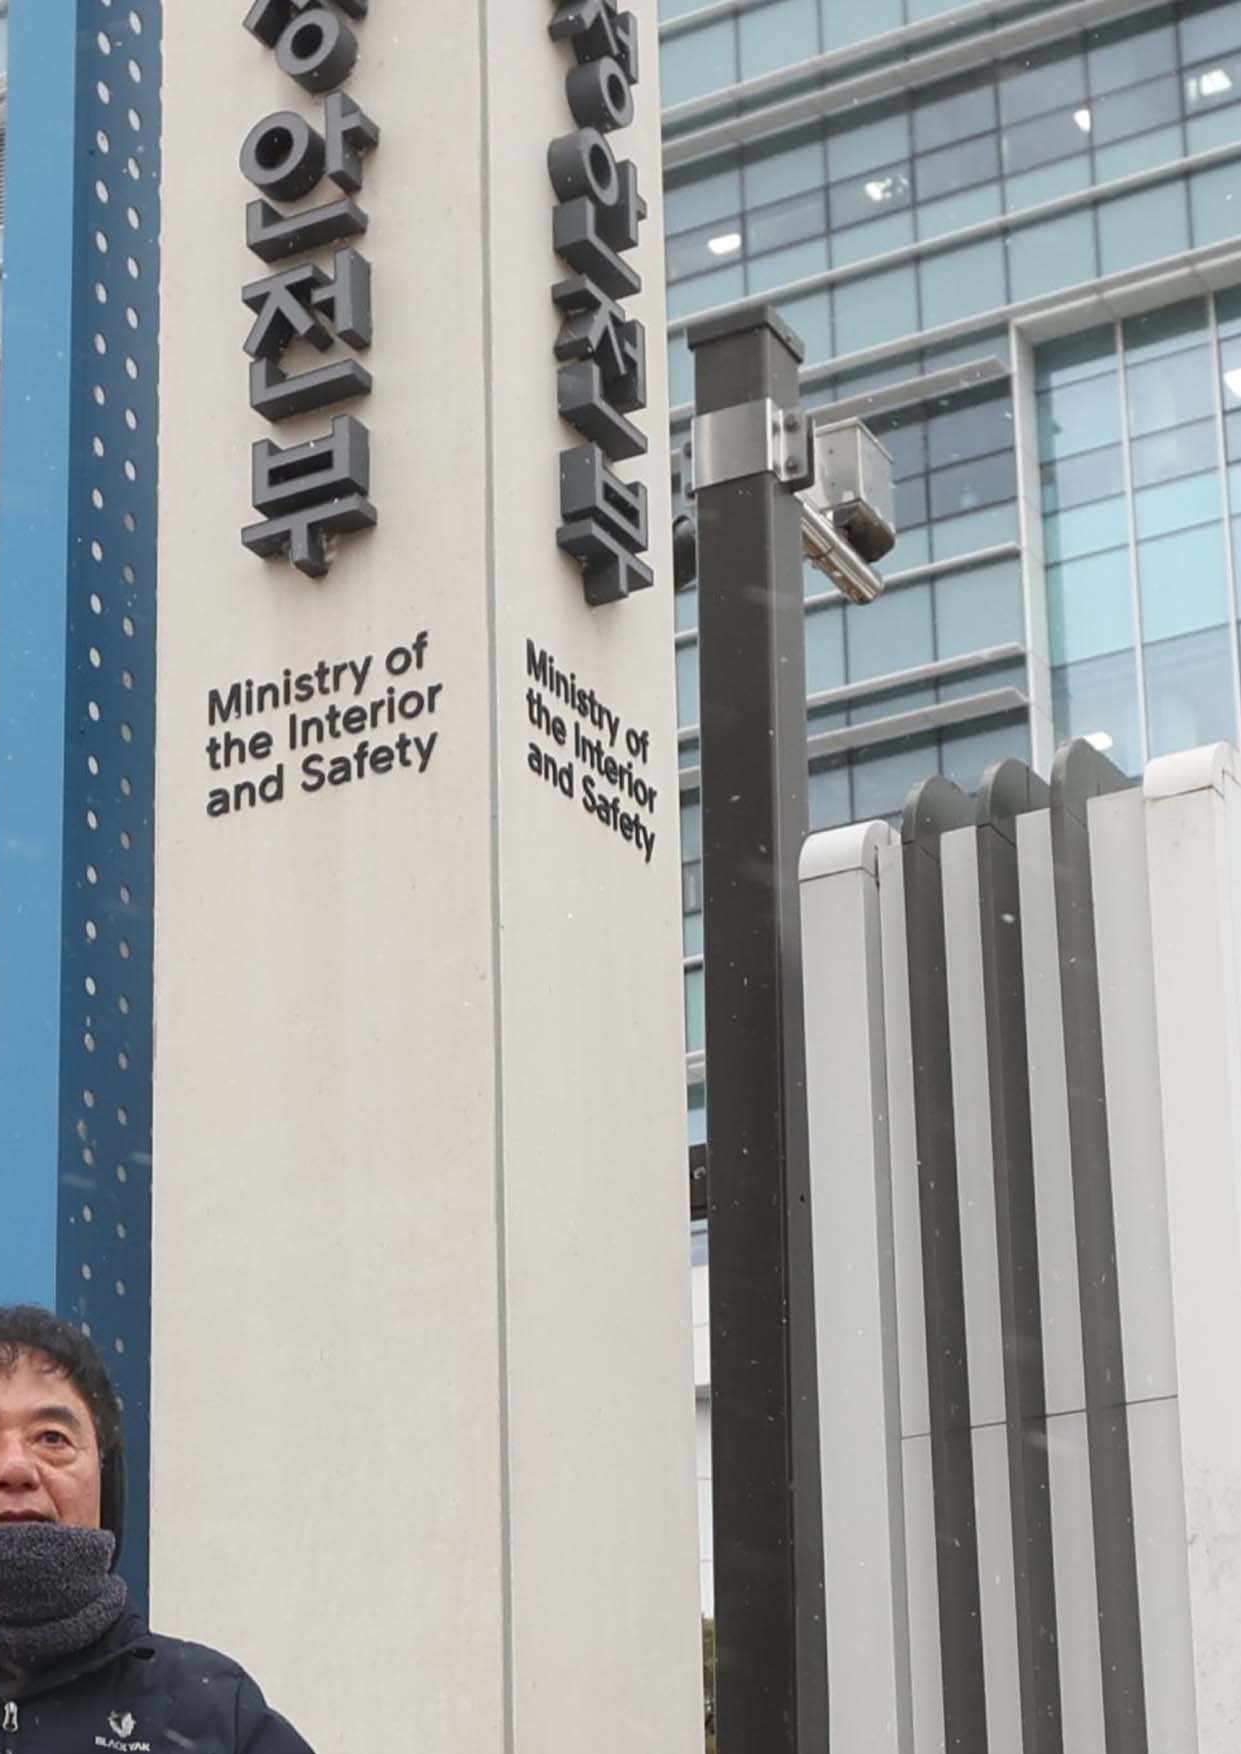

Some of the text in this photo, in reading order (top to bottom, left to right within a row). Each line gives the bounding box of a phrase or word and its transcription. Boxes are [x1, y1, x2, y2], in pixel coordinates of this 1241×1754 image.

[206, 683, 443, 771] the Interior
[207, 631, 429, 727] Ministry of
[526, 637, 649, 763] Ministry of
[206, 731, 438, 818] and Safety
[526, 688, 657, 814] the Interior
[527, 740, 656, 864] and Safety
